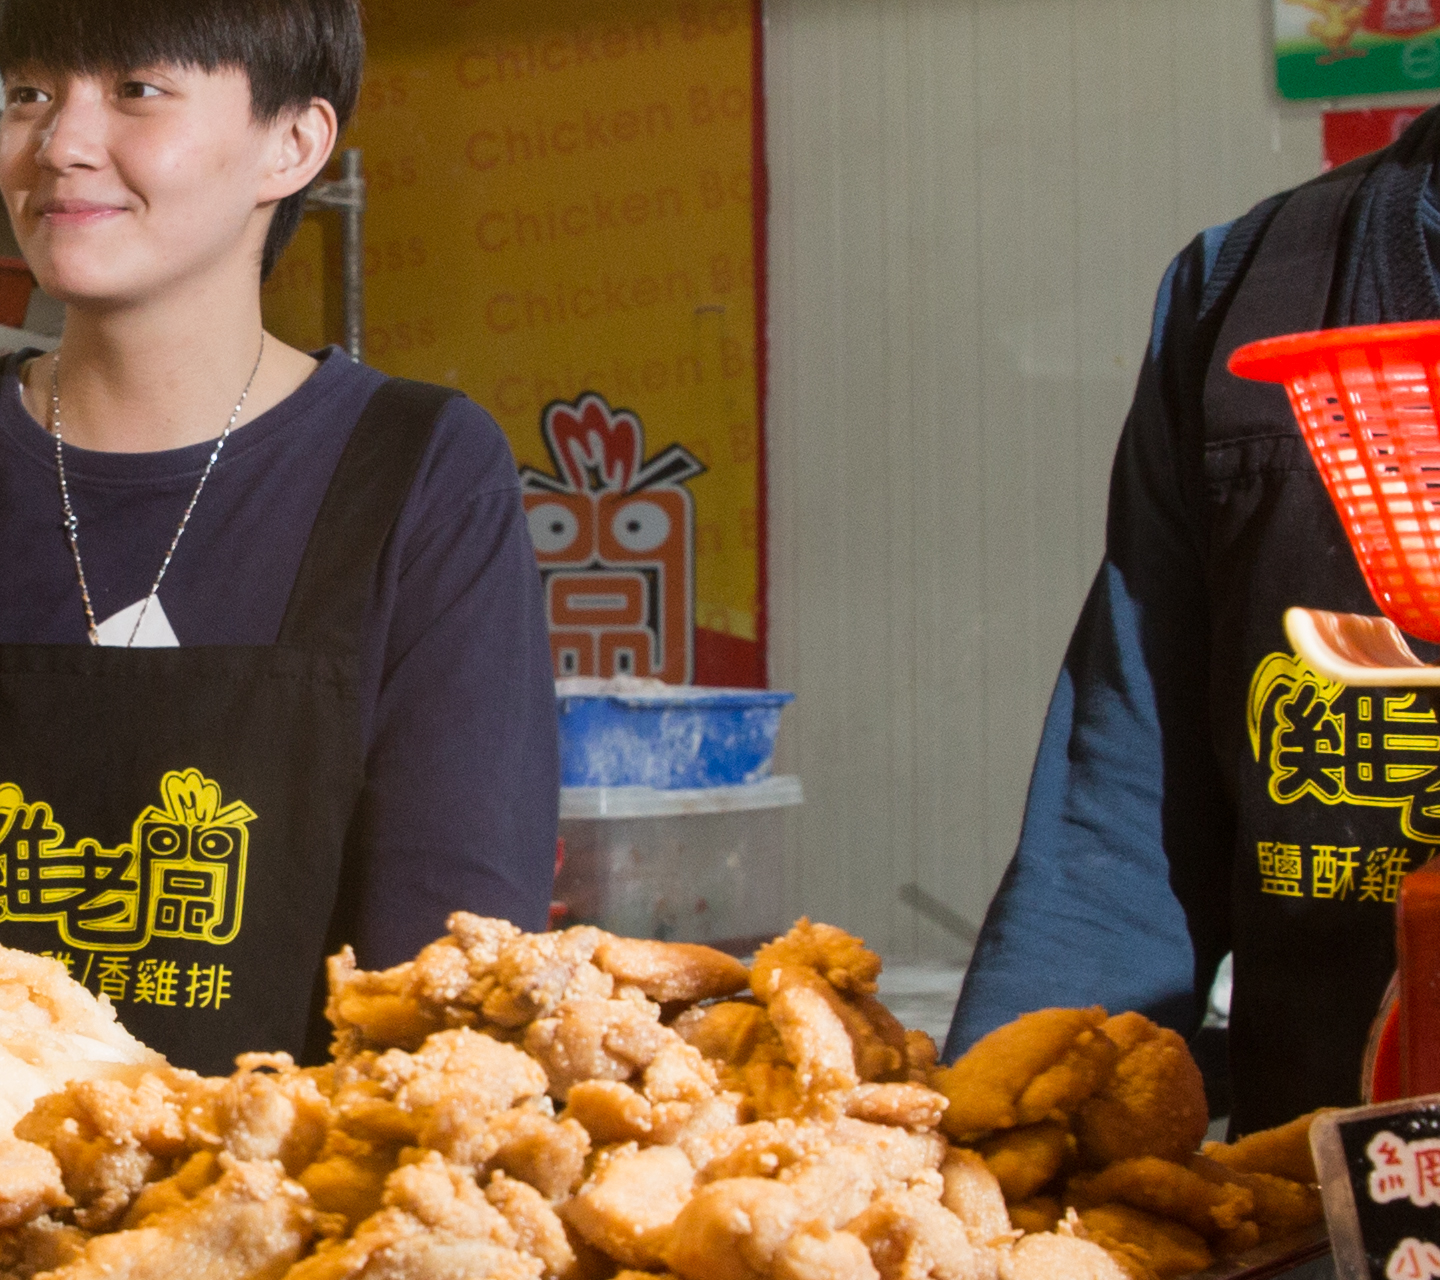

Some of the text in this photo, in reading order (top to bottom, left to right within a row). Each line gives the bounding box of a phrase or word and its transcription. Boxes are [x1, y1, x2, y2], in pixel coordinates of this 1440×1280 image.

[454, 13, 664, 91] Chicken
[463, 96, 675, 172] Chicken
[473, 179, 685, 254] Chicken
